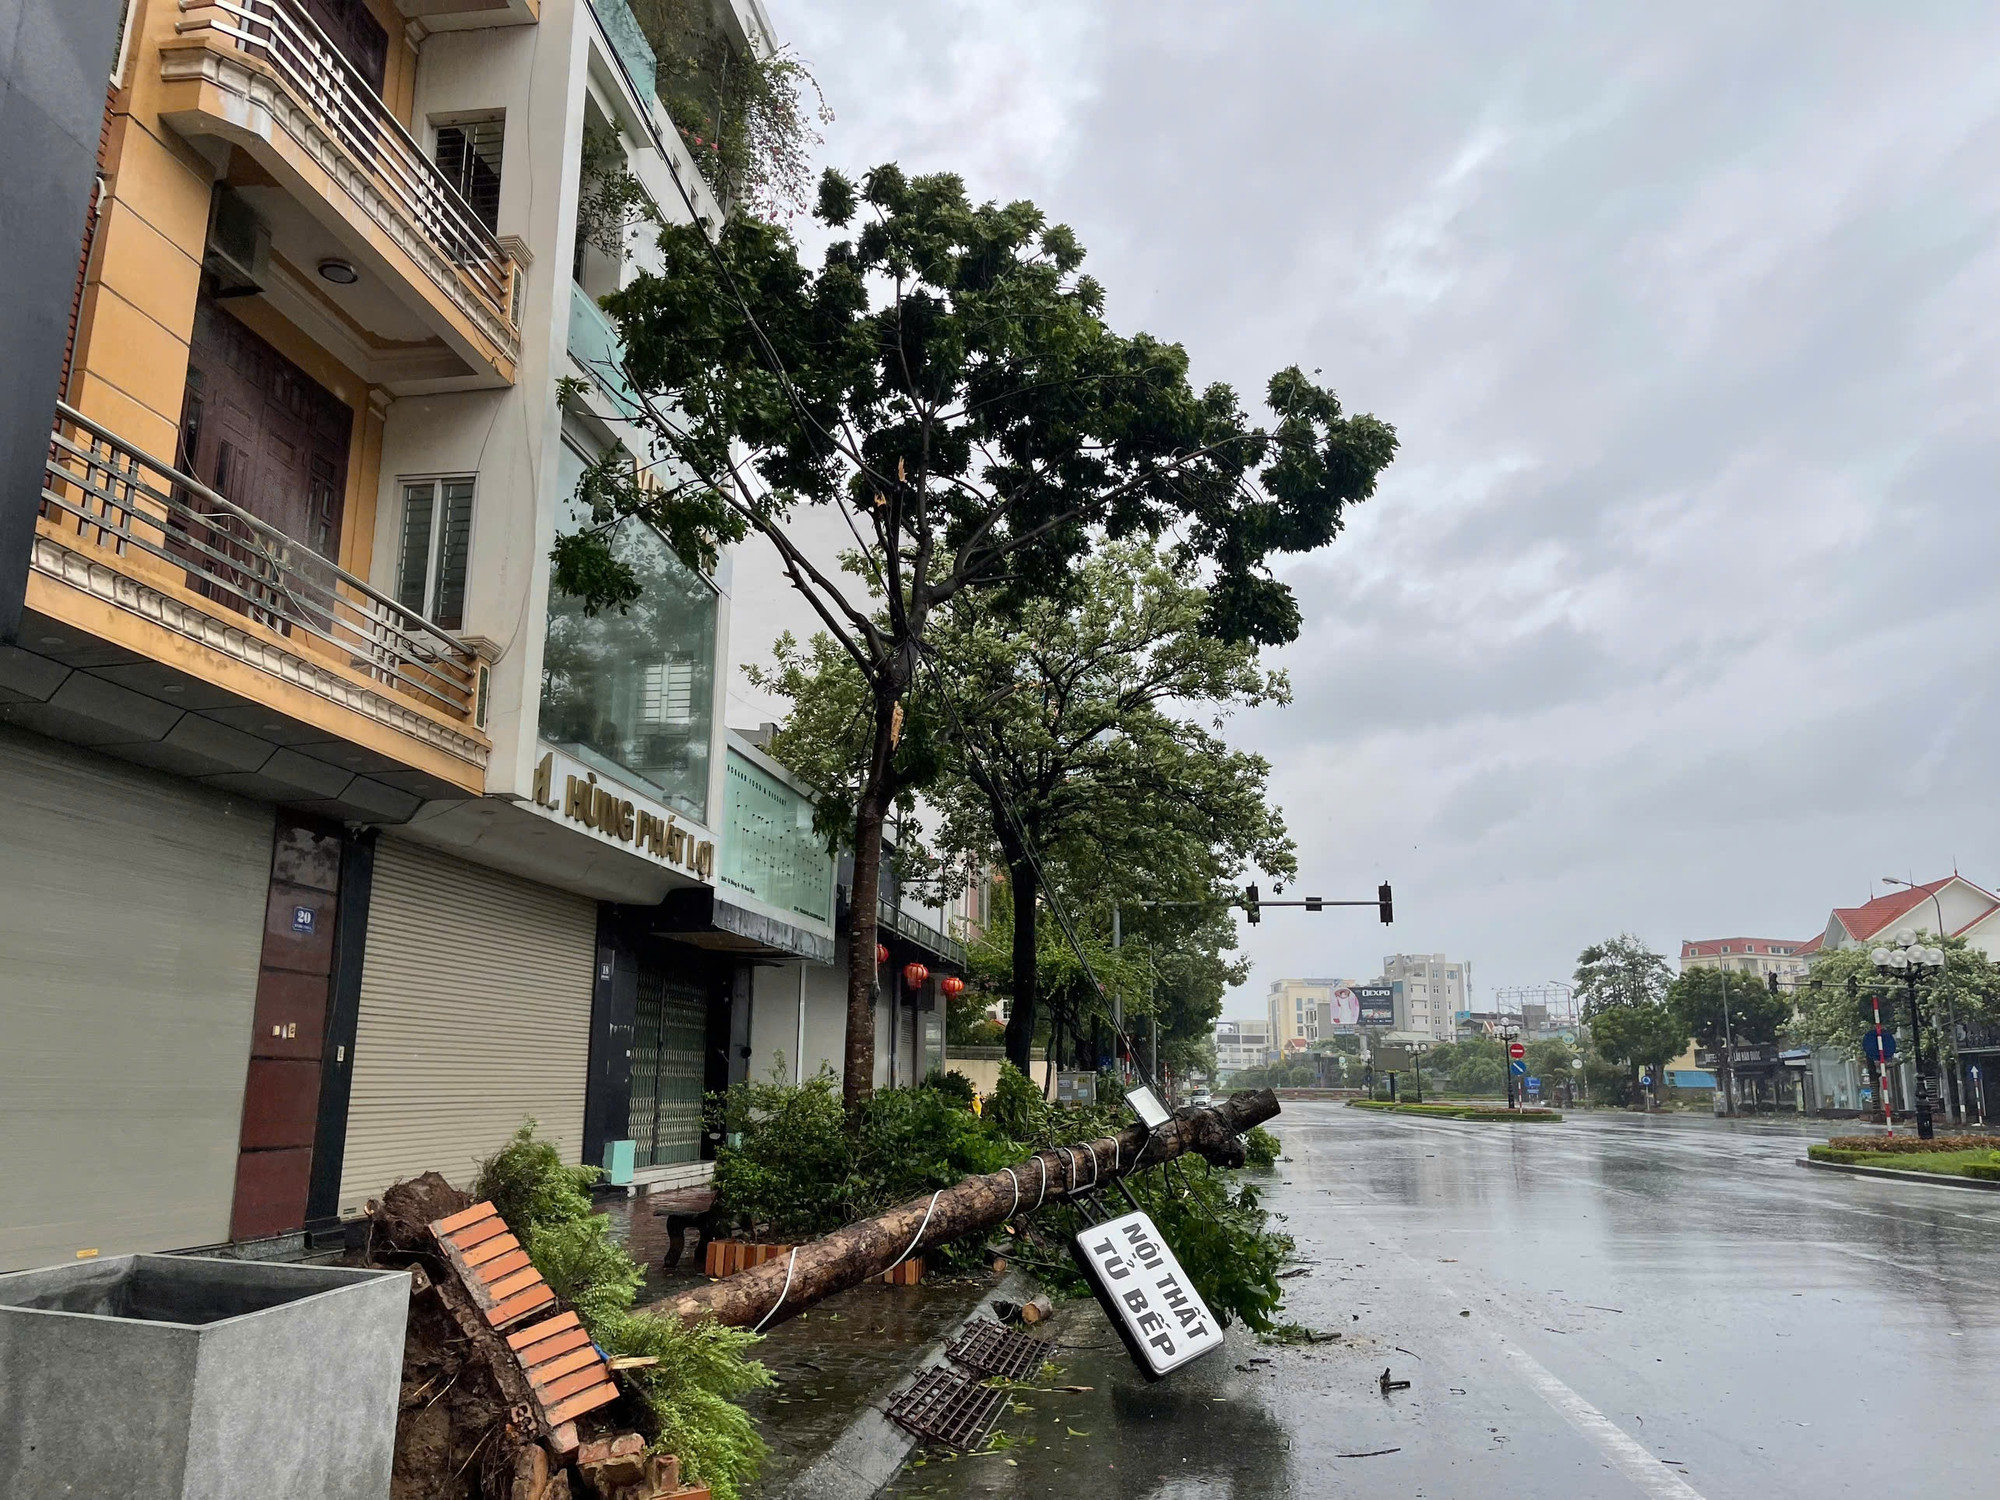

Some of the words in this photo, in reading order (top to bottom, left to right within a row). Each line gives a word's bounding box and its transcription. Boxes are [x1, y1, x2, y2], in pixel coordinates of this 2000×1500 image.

[565, 772, 635, 841] HÙNG
[635, 815, 687, 864] PHÁT
[297, 910, 311, 923] 20
[1093, 1237, 1135, 1280] TỦ
[1122, 1288, 1176, 1356] BẾP
[1122, 1222, 1164, 1271] NỘI
[1155, 1272, 1209, 1339] THẤT
